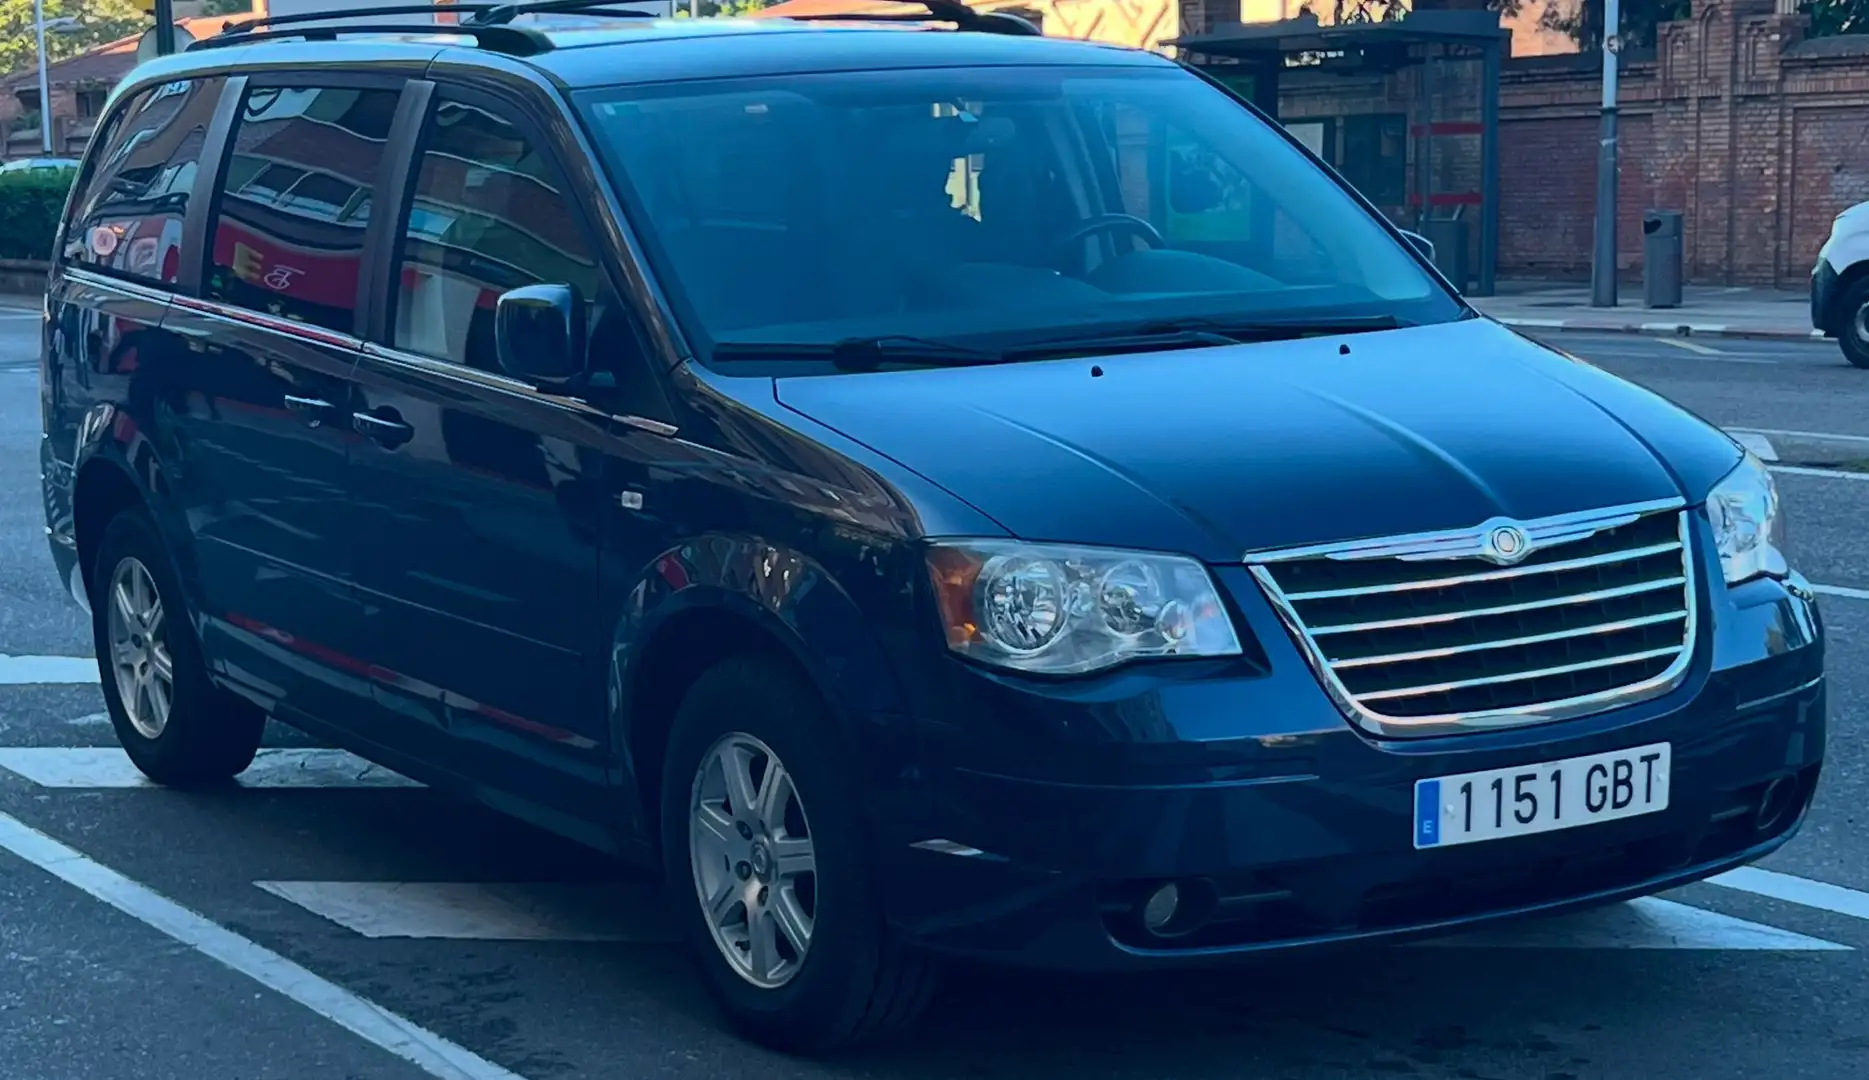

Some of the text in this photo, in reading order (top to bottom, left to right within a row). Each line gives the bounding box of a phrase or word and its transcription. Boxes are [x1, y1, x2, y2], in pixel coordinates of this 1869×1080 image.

[1460, 752, 1660, 832] 1151 GBT
[1423, 820, 1433, 834] E
